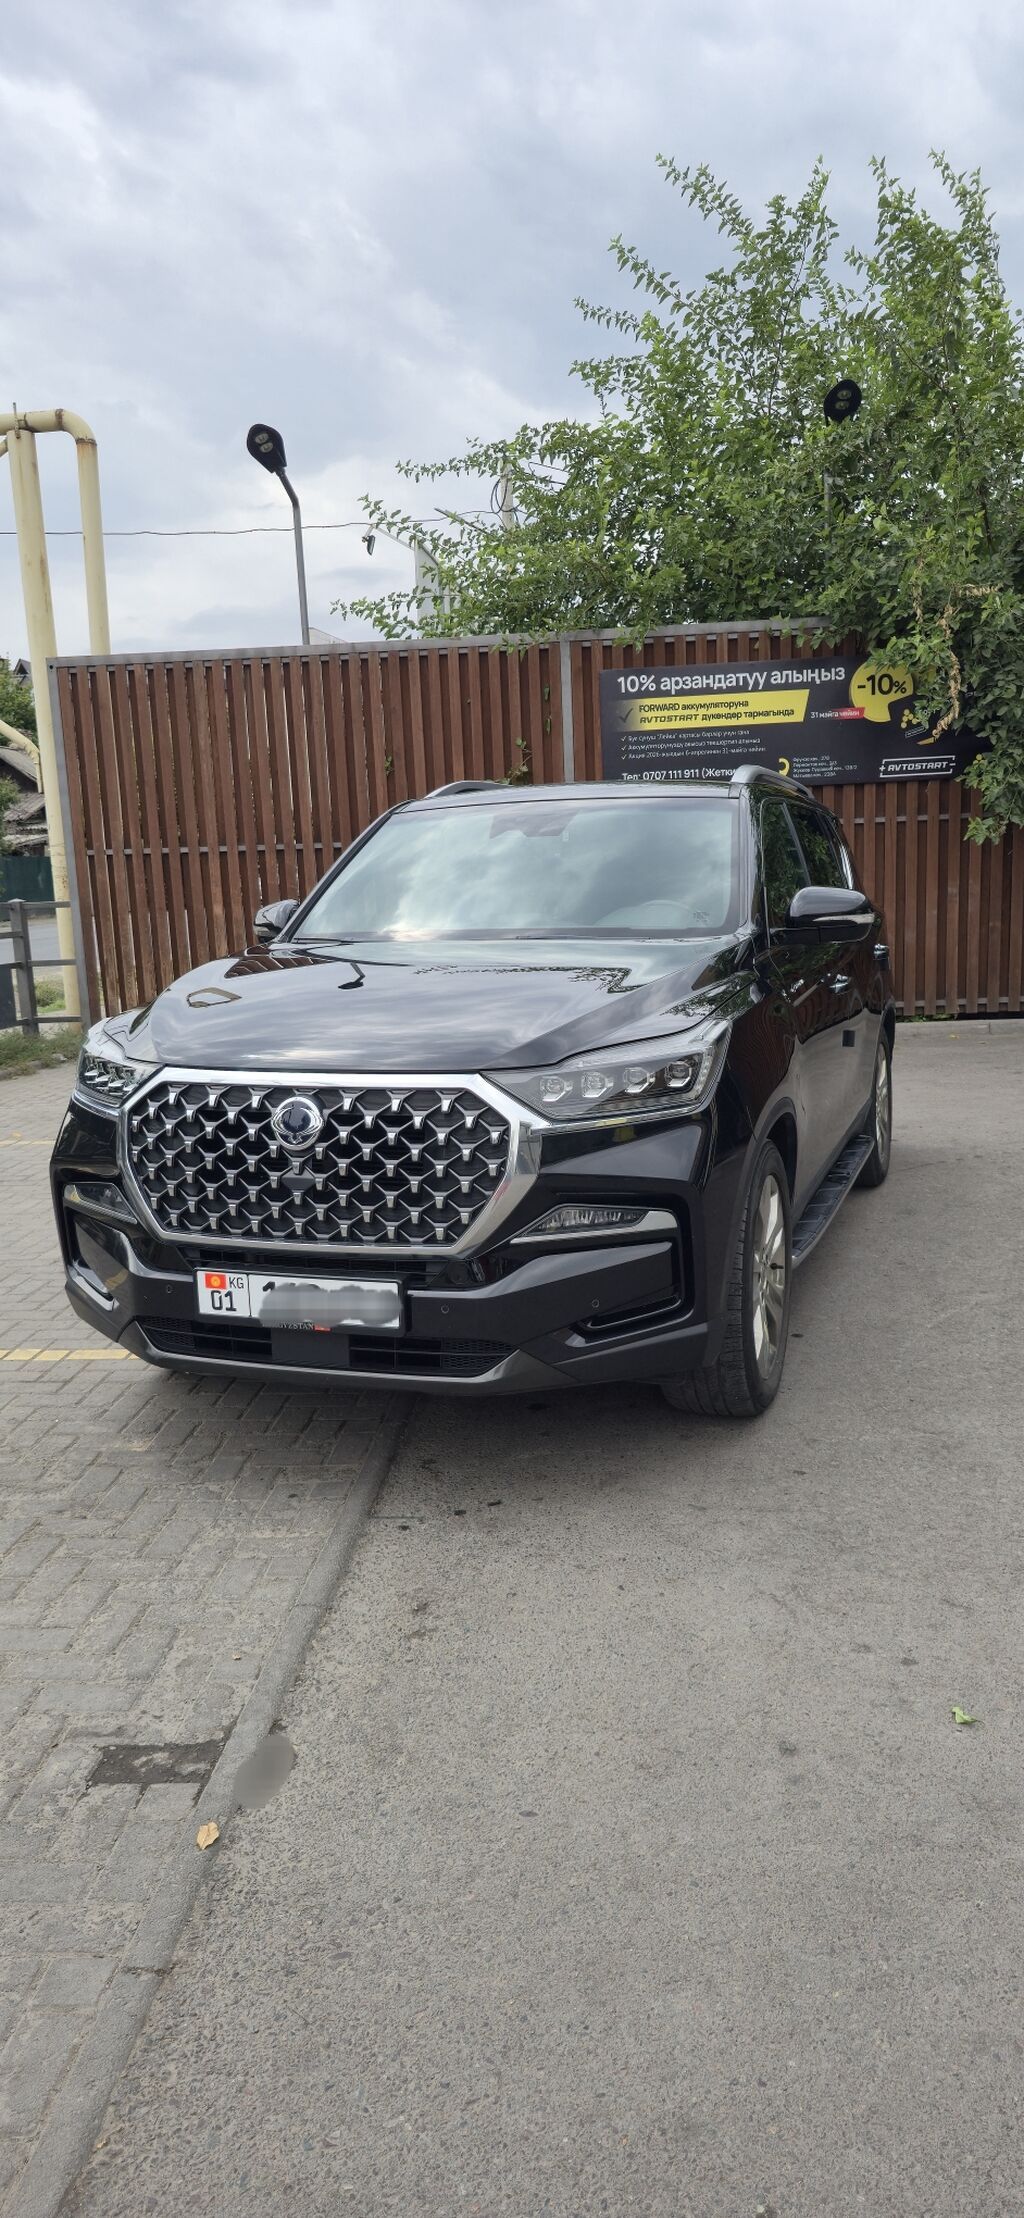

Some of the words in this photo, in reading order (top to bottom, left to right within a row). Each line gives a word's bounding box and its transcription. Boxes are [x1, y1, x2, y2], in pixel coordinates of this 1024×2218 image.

[617, 674, 656, 693] 10%
[660, 671, 768, 695] арзандатуу
[770, 667, 846, 684] алыңыз
[857, 673, 907, 695] -10%
[639, 702, 680, 712] FORWARD
[681, 700, 749, 711] аккумуляторуна
[640, 714, 700, 724] AVTOSTART
[743, 708, 795, 719] тармагында
[810, 711, 819, 719] 31
[887, 761, 948, 772] AVTOSTART
[643, 771, 667, 780] 0707
[668, 770, 682, 779] 111
[684, 769, 699, 778] 911
[229, 1277, 245, 1289] KG
[210, 1290, 237, 1312] 01
